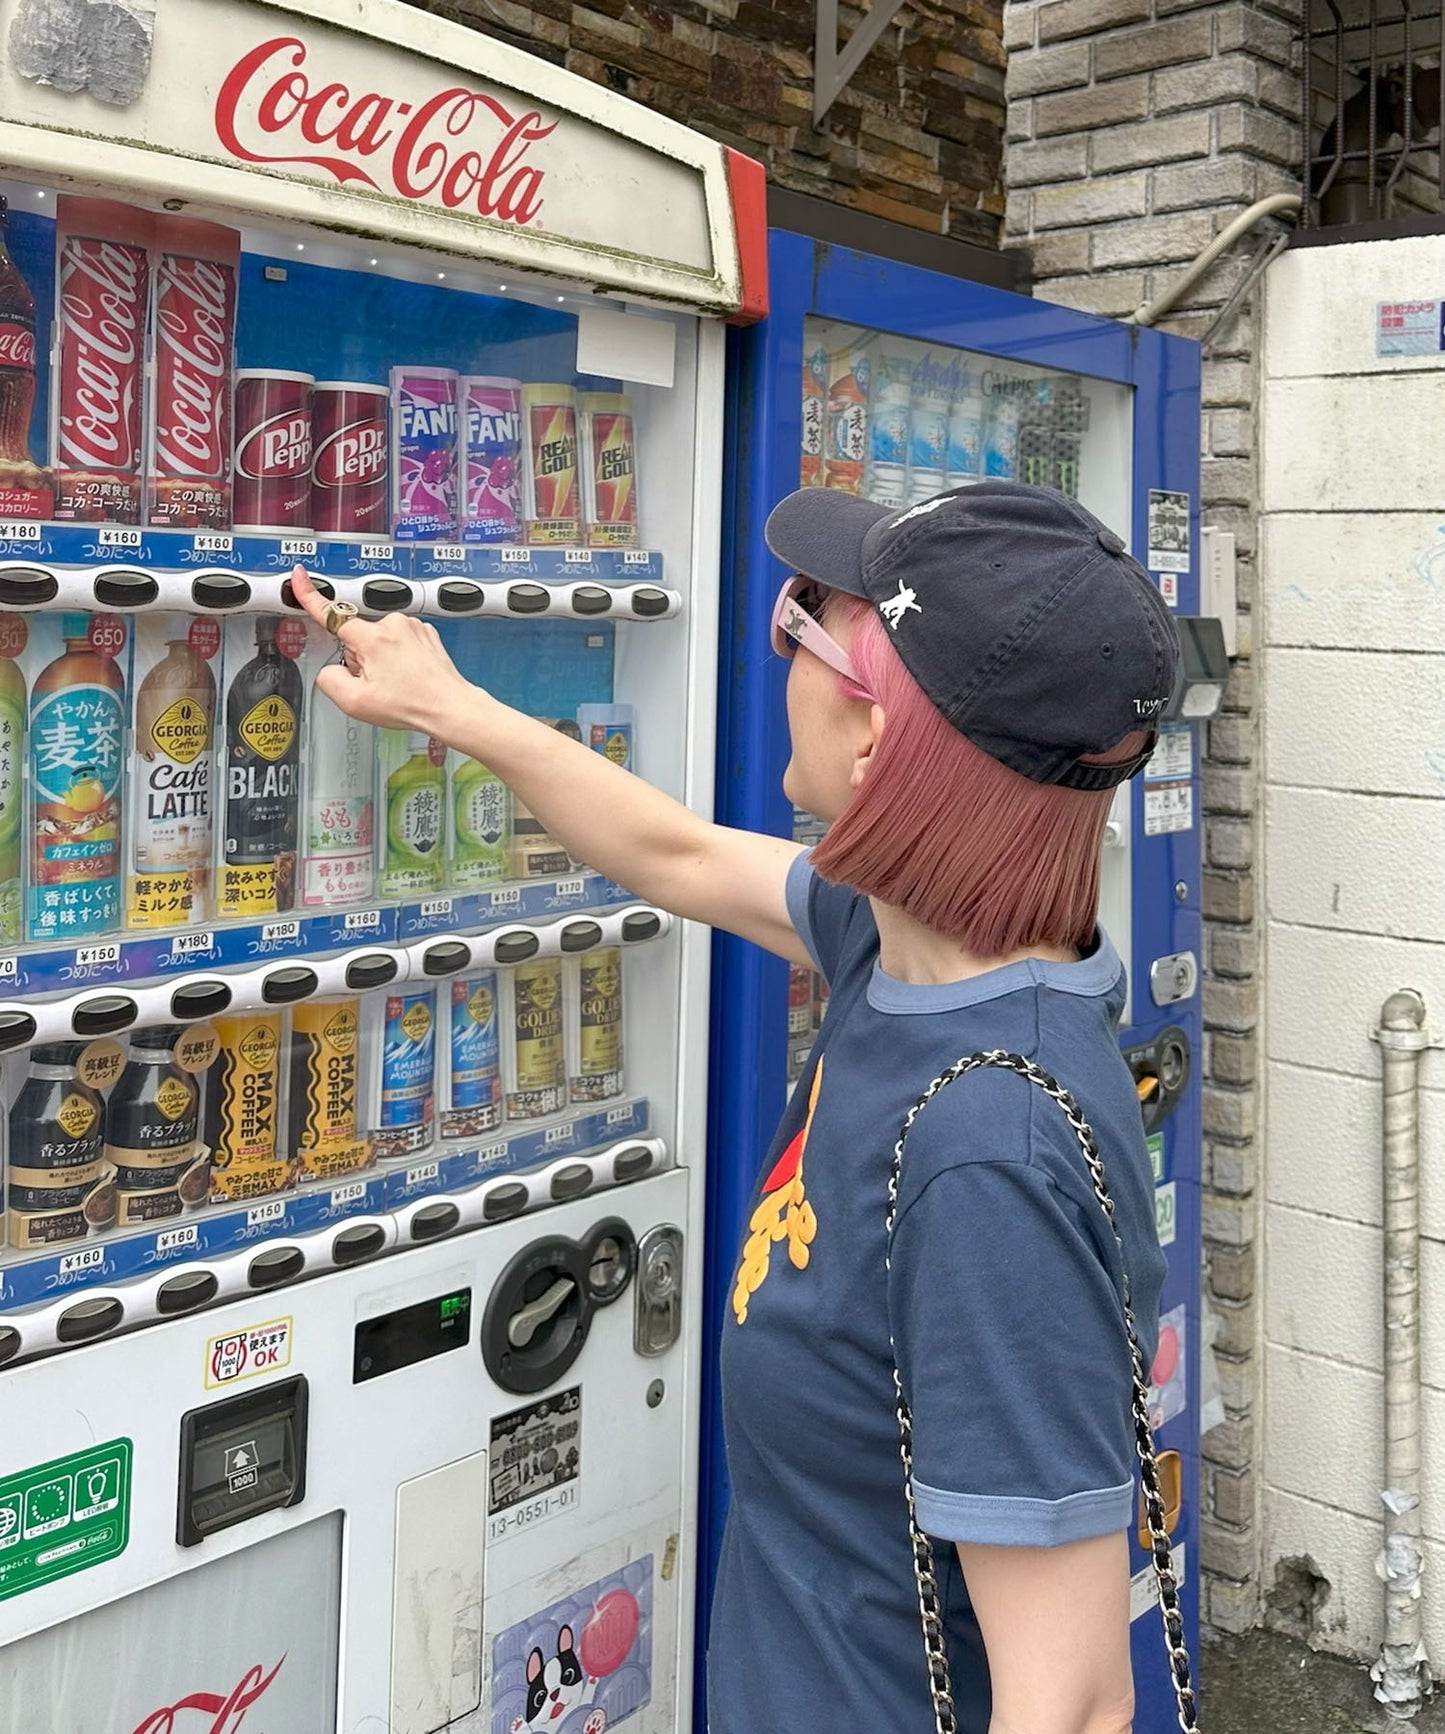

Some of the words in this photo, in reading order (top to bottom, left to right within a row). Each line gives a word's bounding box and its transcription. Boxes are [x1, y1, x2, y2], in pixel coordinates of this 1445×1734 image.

[215, 37, 561, 224] Coca-Cola
[59, 239, 138, 467] Coca-Cola
[155, 255, 226, 476] Coca-Cola
[289, 420, 310, 440] Dr
[849, 405, 864, 459] 麦茶
[360, 429, 383, 453] Dr
[75, 483, 130, 497] この爽快感
[170, 490, 222, 503] この爽快感
[0, 526, 36, 538] ¥180
[104, 532, 138, 544] ¥160
[198, 538, 230, 549] ¥160
[284, 543, 313, 552] ¥150
[364, 548, 390, 557] ¥150
[437, 549, 461, 558] ¥150
[505, 551, 528, 560] ¥150
[568, 552, 589, 561] ¥140
[627, 553, 647, 561] ¥140
[93, 629, 123, 645] 650
[156, 724, 209, 737] GEORGIA
[245, 721, 293, 735] GEORGIA
[36, 717, 120, 771] 麦茶
[169, 738, 200, 750] Coffee
[257, 734, 286, 747] Coffee
[150, 761, 208, 790] Café
[229, 764, 298, 800] BLACK
[148, 791, 208, 819] LATTE
[479, 784, 499, 830] 綾鷹
[321, 807, 351, 829] もも
[413, 791, 434, 838] 綾鷹
[52, 843, 113, 859] カフェインゼロ
[136, 879, 193, 895] 軽やかな
[225, 887, 276, 903] 深いコク
[558, 882, 581, 893] ¥170
[44, 885, 116, 907] 香ばしくて、
[138, 896, 193, 912] ミルク感
[494, 891, 518, 902] ¥150
[40, 902, 118, 927] 後味すっきり
[424, 902, 450, 913] ¥150
[348, 914, 376, 925] ¥160
[267, 924, 295, 936] ¥180
[178, 934, 208, 948] ¥180
[80, 947, 115, 962] ¥150
[180, 1039, 215, 1057] 高級豆
[84, 1053, 121, 1072] 高級豆
[183, 1053, 213, 1066] ブレンド
[85, 1069, 117, 1082] ブレンド
[327, 1057, 340, 1120] COFFEE
[340, 1053, 355, 1118] MAX
[157, 1091, 192, 1104] GEORGIA
[256, 1070, 273, 1136] MAX
[241, 1073, 256, 1139] COFFEE
[60, 1108, 95, 1122] GEORGIA
[609, 1108, 631, 1121] ¥140
[547, 1127, 571, 1139] ¥140
[313, 1146, 365, 1165] やみつきの甘さ
[481, 1146, 506, 1159] ¥140
[319, 1157, 359, 1175] 元気MAX
[409, 1166, 436, 1180] ¥140
[226, 1167, 283, 1186] やみつきの甘さ
[232, 1177, 277, 1195] 元気MAX
[335, 1185, 362, 1199] ¥150
[251, 1205, 281, 1219] ¥150
[161, 1230, 193, 1246] ¥160
[65, 1251, 100, 1268] ¥160
[250, 1332, 287, 1351] 使えます
[222, 1357, 236, 1367] 1000
[254, 1346, 278, 1367] OK
[233, 1474, 253, 1488] 1000
[491, 1488, 574, 1537] 13-0551-01
[29, 1518, 65, 1537] ヒートポンプ
